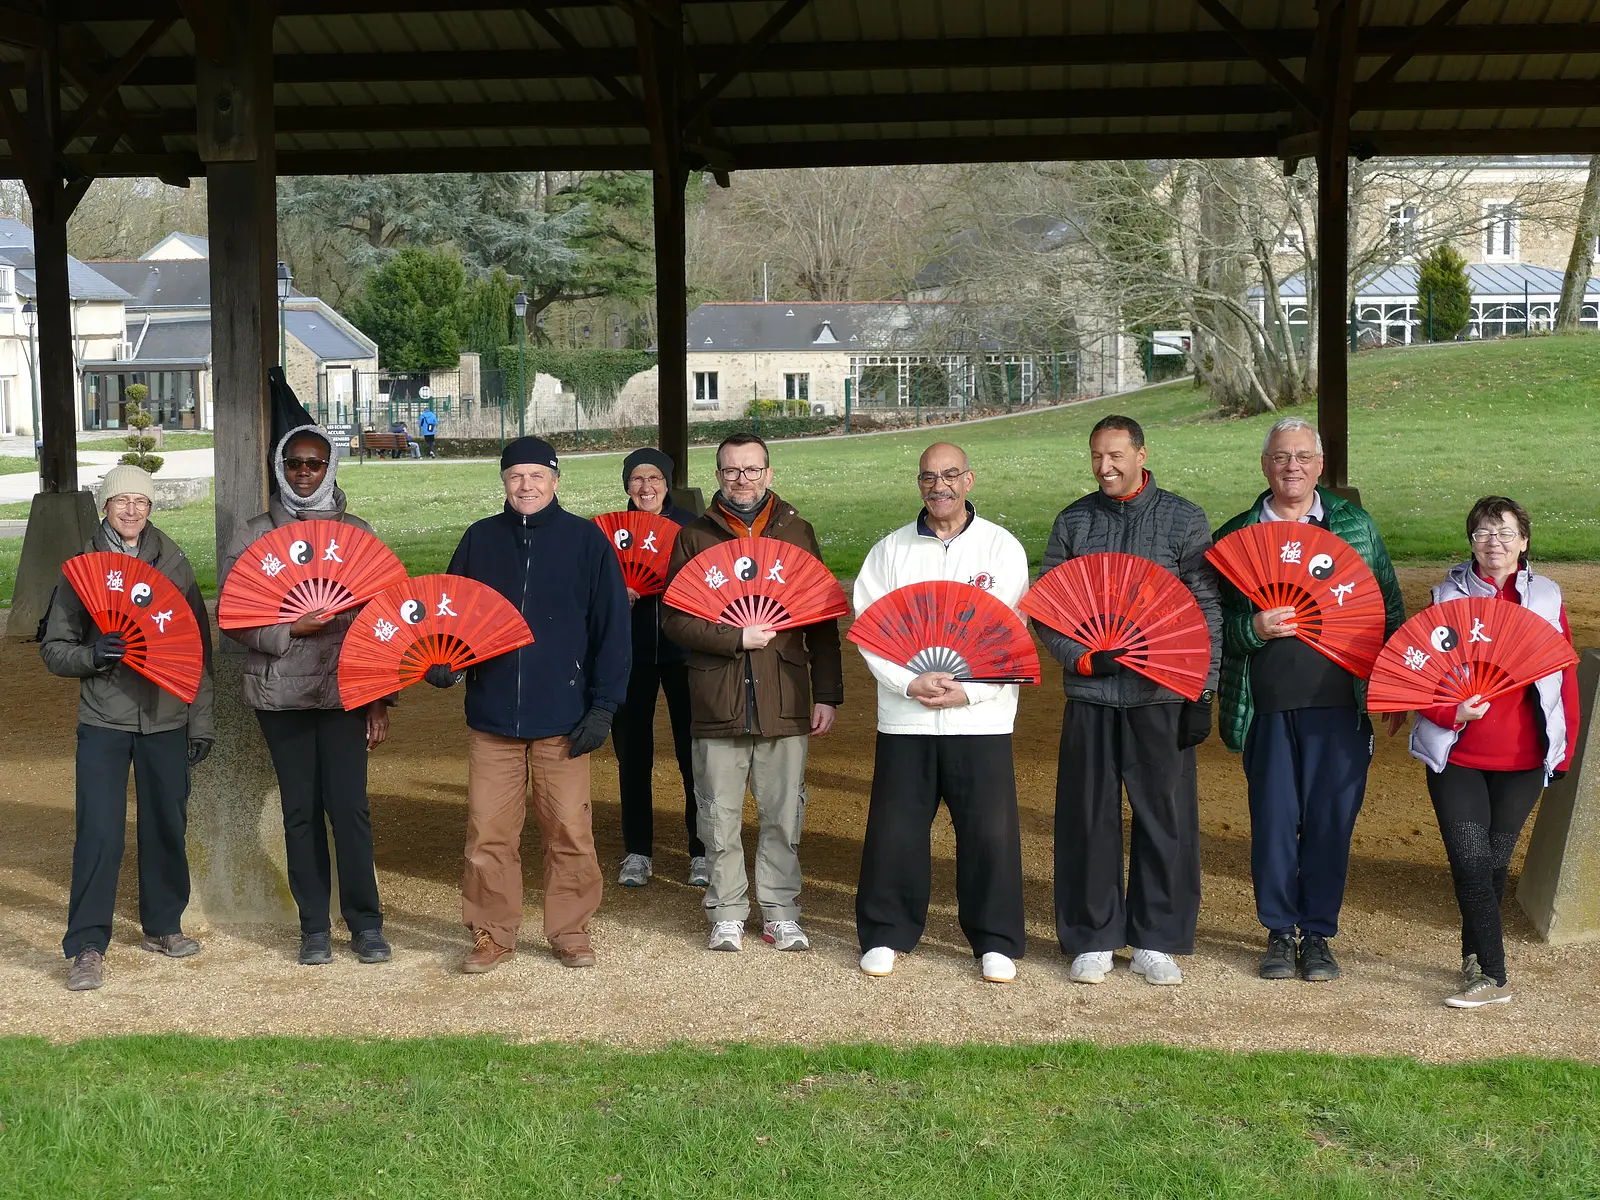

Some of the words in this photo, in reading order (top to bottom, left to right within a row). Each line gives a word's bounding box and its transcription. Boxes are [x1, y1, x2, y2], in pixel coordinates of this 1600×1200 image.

[322, 538, 343, 562] 太
[640, 530, 659, 553] 太
[765, 559, 785, 584] 太
[435, 593, 458, 617] 太
[1468, 617, 1493, 643] 太
